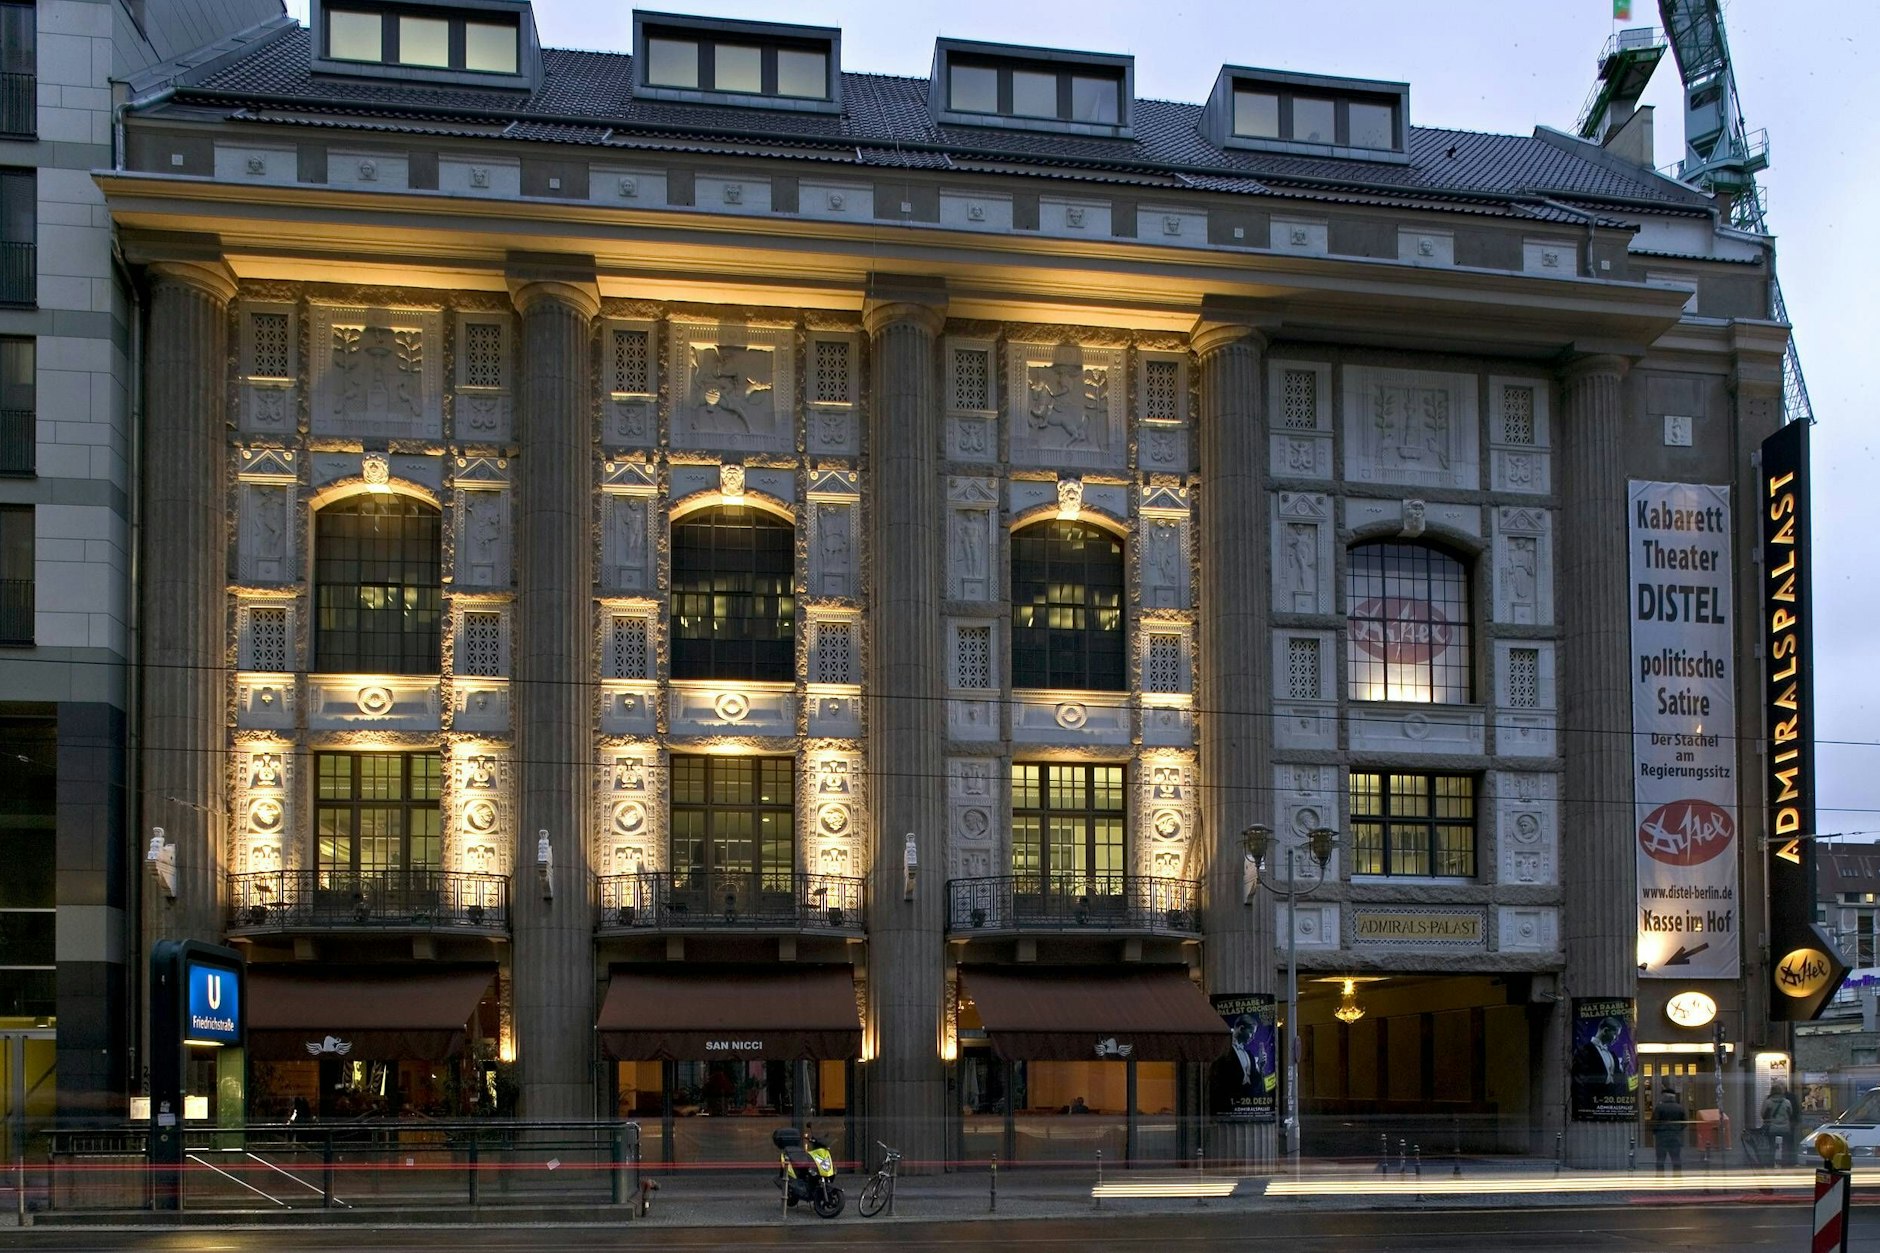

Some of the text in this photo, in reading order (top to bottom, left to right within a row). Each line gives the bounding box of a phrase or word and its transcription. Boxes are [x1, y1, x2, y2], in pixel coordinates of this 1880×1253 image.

[1637, 500, 1723, 532] Kabarett
[1643, 540, 1719, 571] Theater
[1638, 583, 1725, 624] DISTEL
[1640, 648, 1725, 683] politische
[1769, 471, 1800, 865] ADMIRALSPALAST
[1657, 687, 1710, 717] Satire
[1651, 733, 1719, 748] Der Stachel
[1676, 751, 1695, 763] am
[1641, 763, 1731, 780] Regierungssitz
[1642, 885, 1733, 900] www.distel-berlin.de
[1643, 909, 1683, 932] Kasse
[1707, 910, 1732, 933] Hof
[207, 974, 221, 1010] U
[1216, 1001, 1234, 1010] MAX
[192, 1015, 235, 1032] Friedrichstraße
[705, 1041, 763, 1050] SAN NICCI
